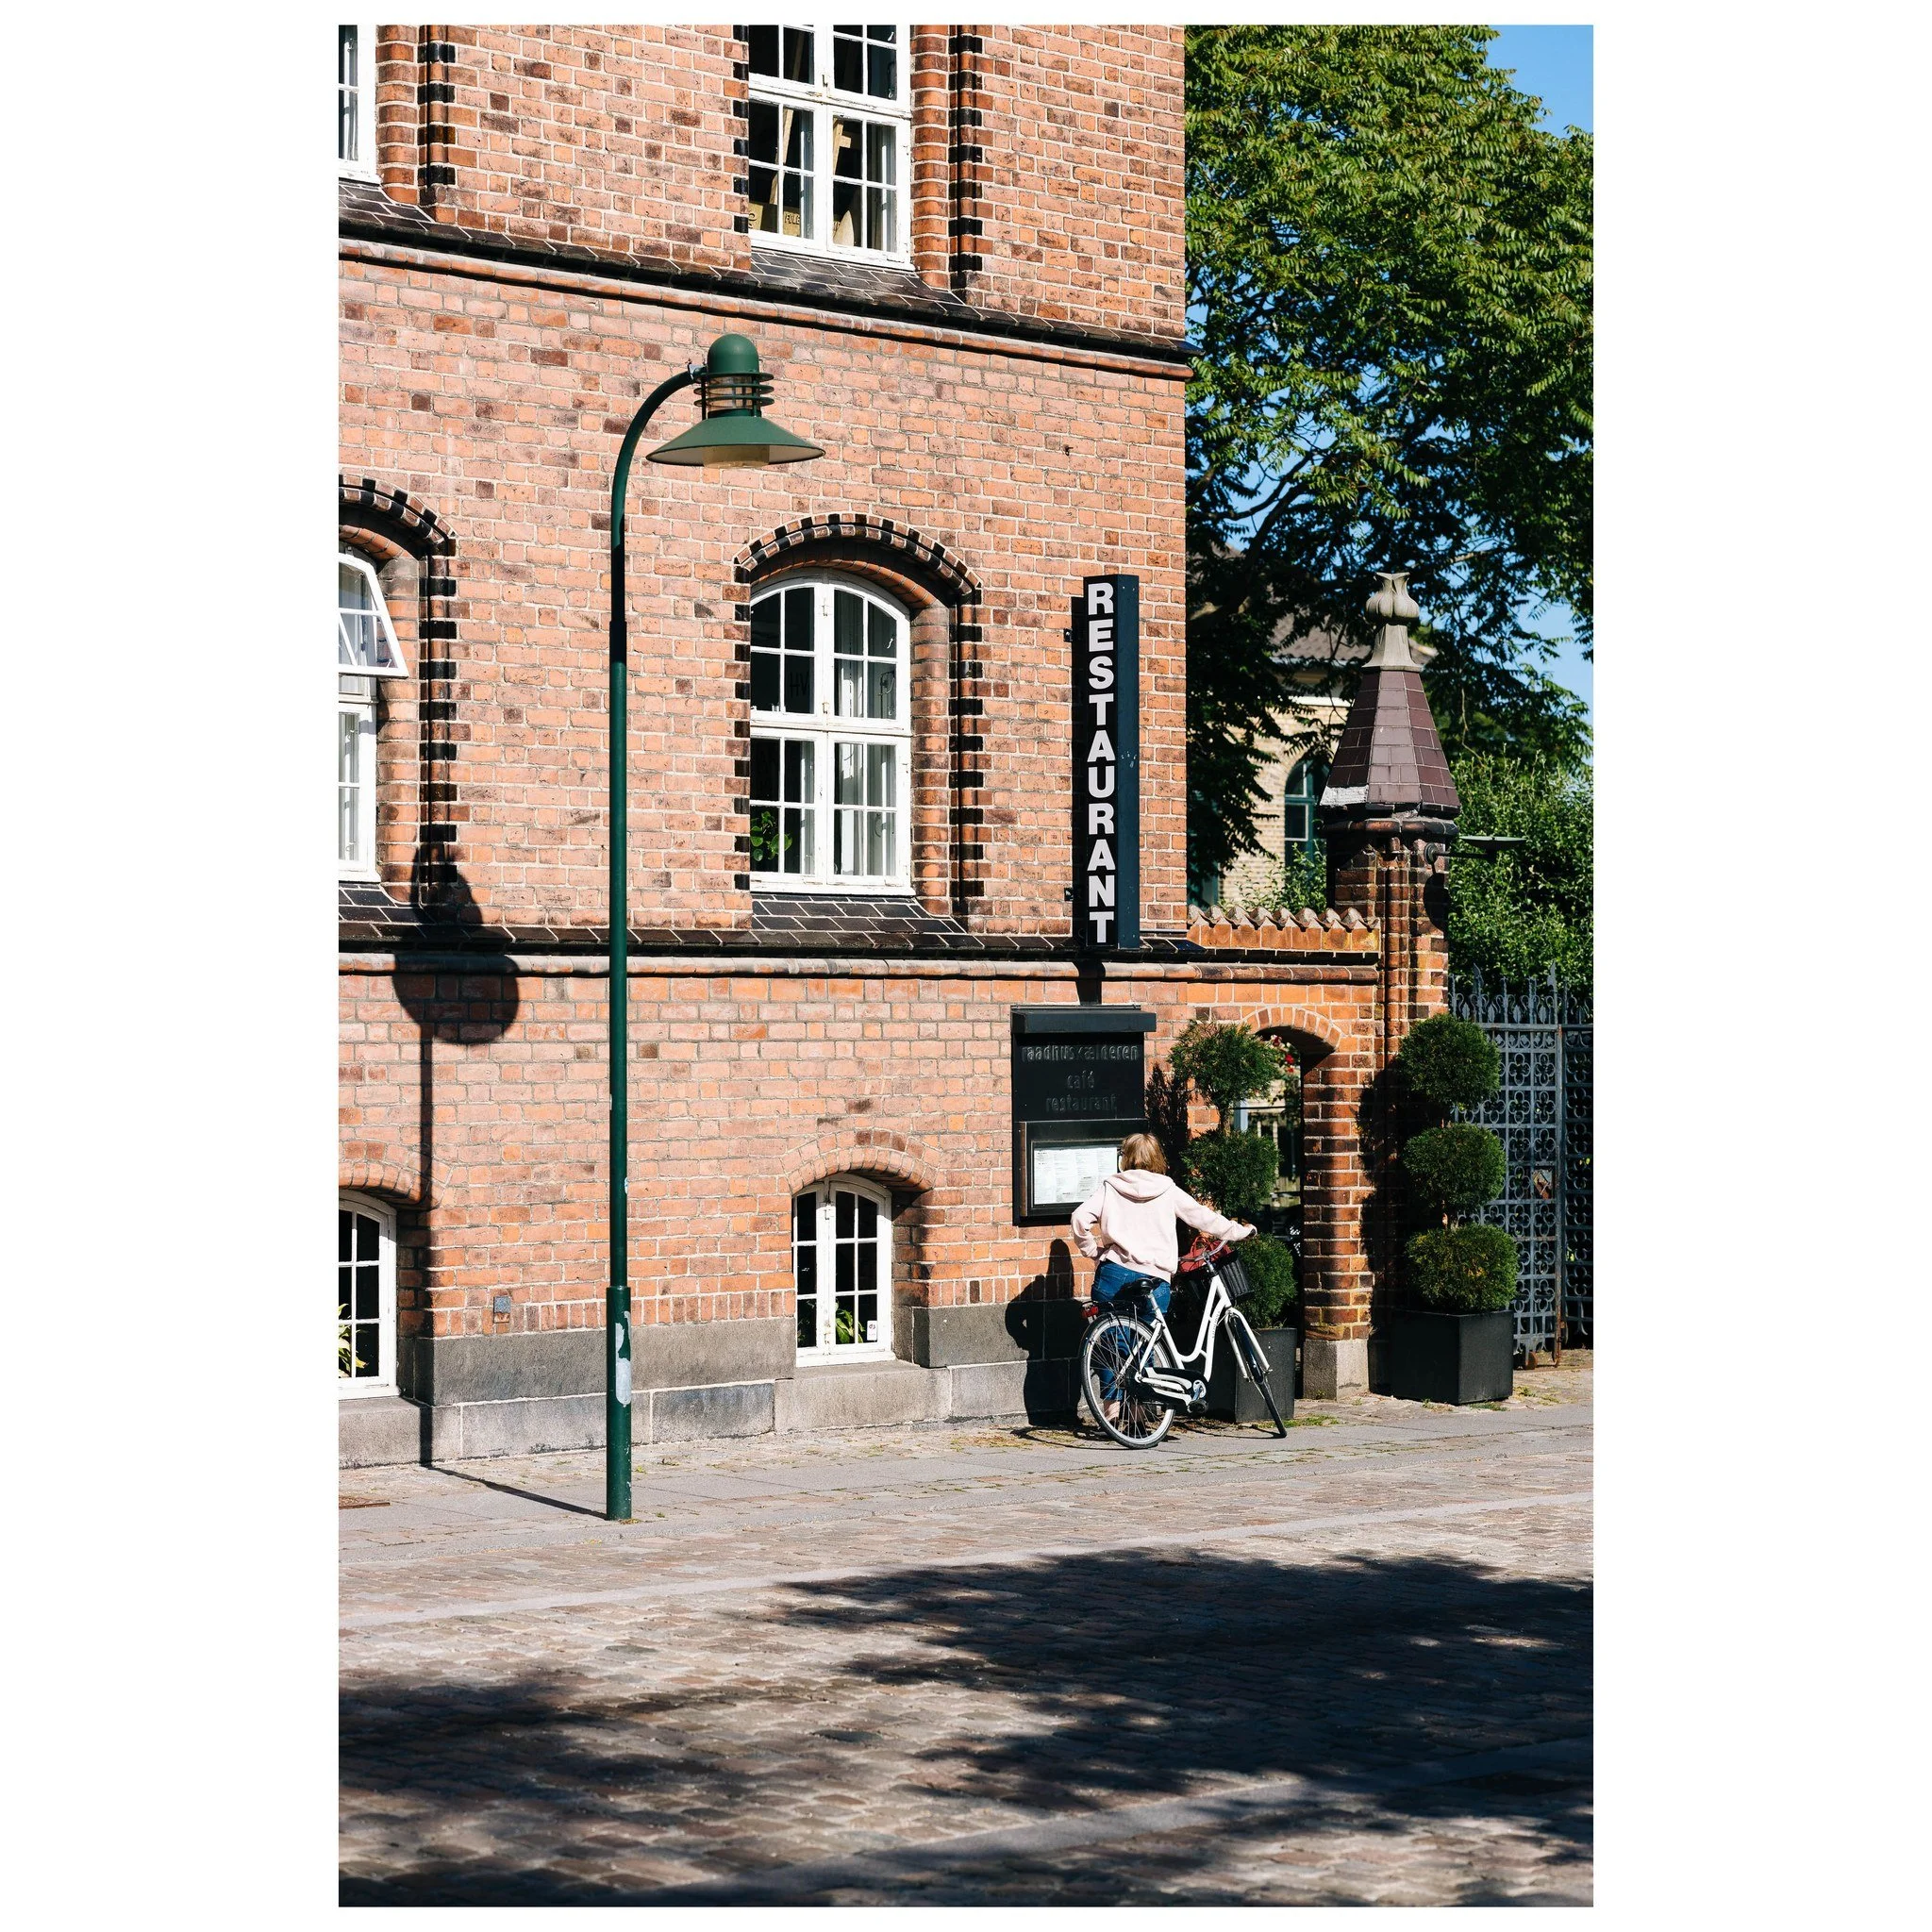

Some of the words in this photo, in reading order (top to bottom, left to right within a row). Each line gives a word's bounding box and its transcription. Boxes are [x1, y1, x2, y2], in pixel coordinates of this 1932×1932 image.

[1087, 581, 1116, 944] RESTAURANT
[1067, 1071, 1096, 1089] café
[1045, 1094, 1117, 1112] restaurant
